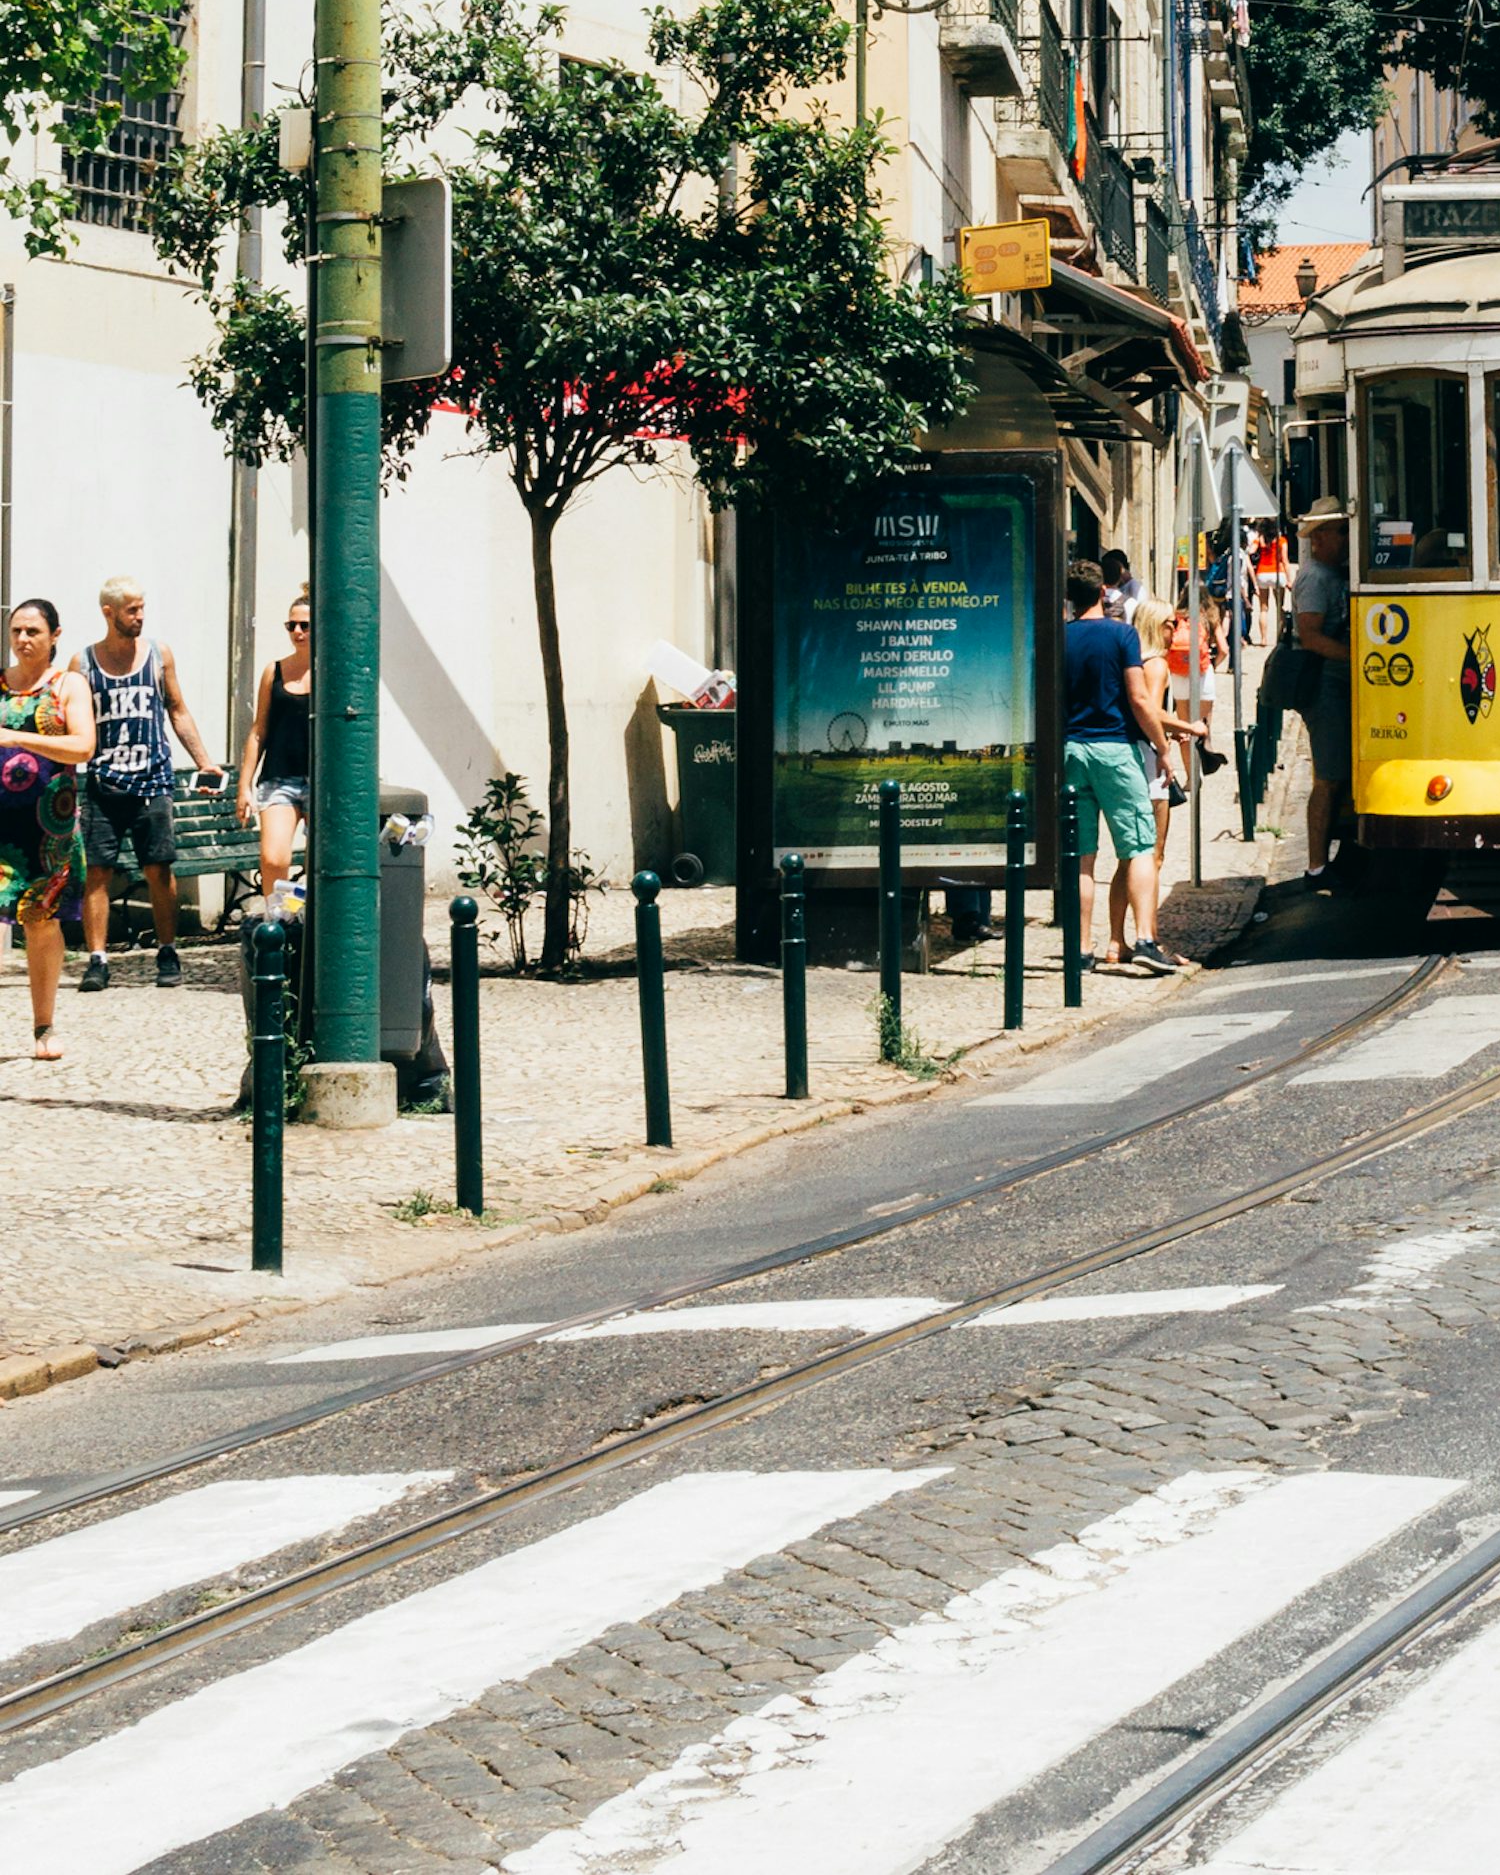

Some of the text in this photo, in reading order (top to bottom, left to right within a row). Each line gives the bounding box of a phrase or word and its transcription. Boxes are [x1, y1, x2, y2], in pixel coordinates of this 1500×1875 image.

[920, 551, 948, 561] TRIBO
[1375, 552, 1390, 564] 07
[845, 579, 968, 595] BILHETES À VENDA
[813, 595, 1000, 610] NAS LOJAS MEO E EM MEO.PT
[856, 619, 958, 632] SHAWN MENDES
[880, 635, 933, 647] J BALVIN
[860, 650, 954, 663] JASON DERULO
[863, 665, 950, 678] MARSHMELLO
[878, 681, 936, 694] LIL PUMP
[93, 685, 155, 724] LIKE
[872, 697, 941, 709] HARDWELL
[118, 722, 130, 744] A
[908, 782, 949, 792] AGOSTO
[918, 792, 934, 803] DO
[935, 792, 958, 802] MAR
